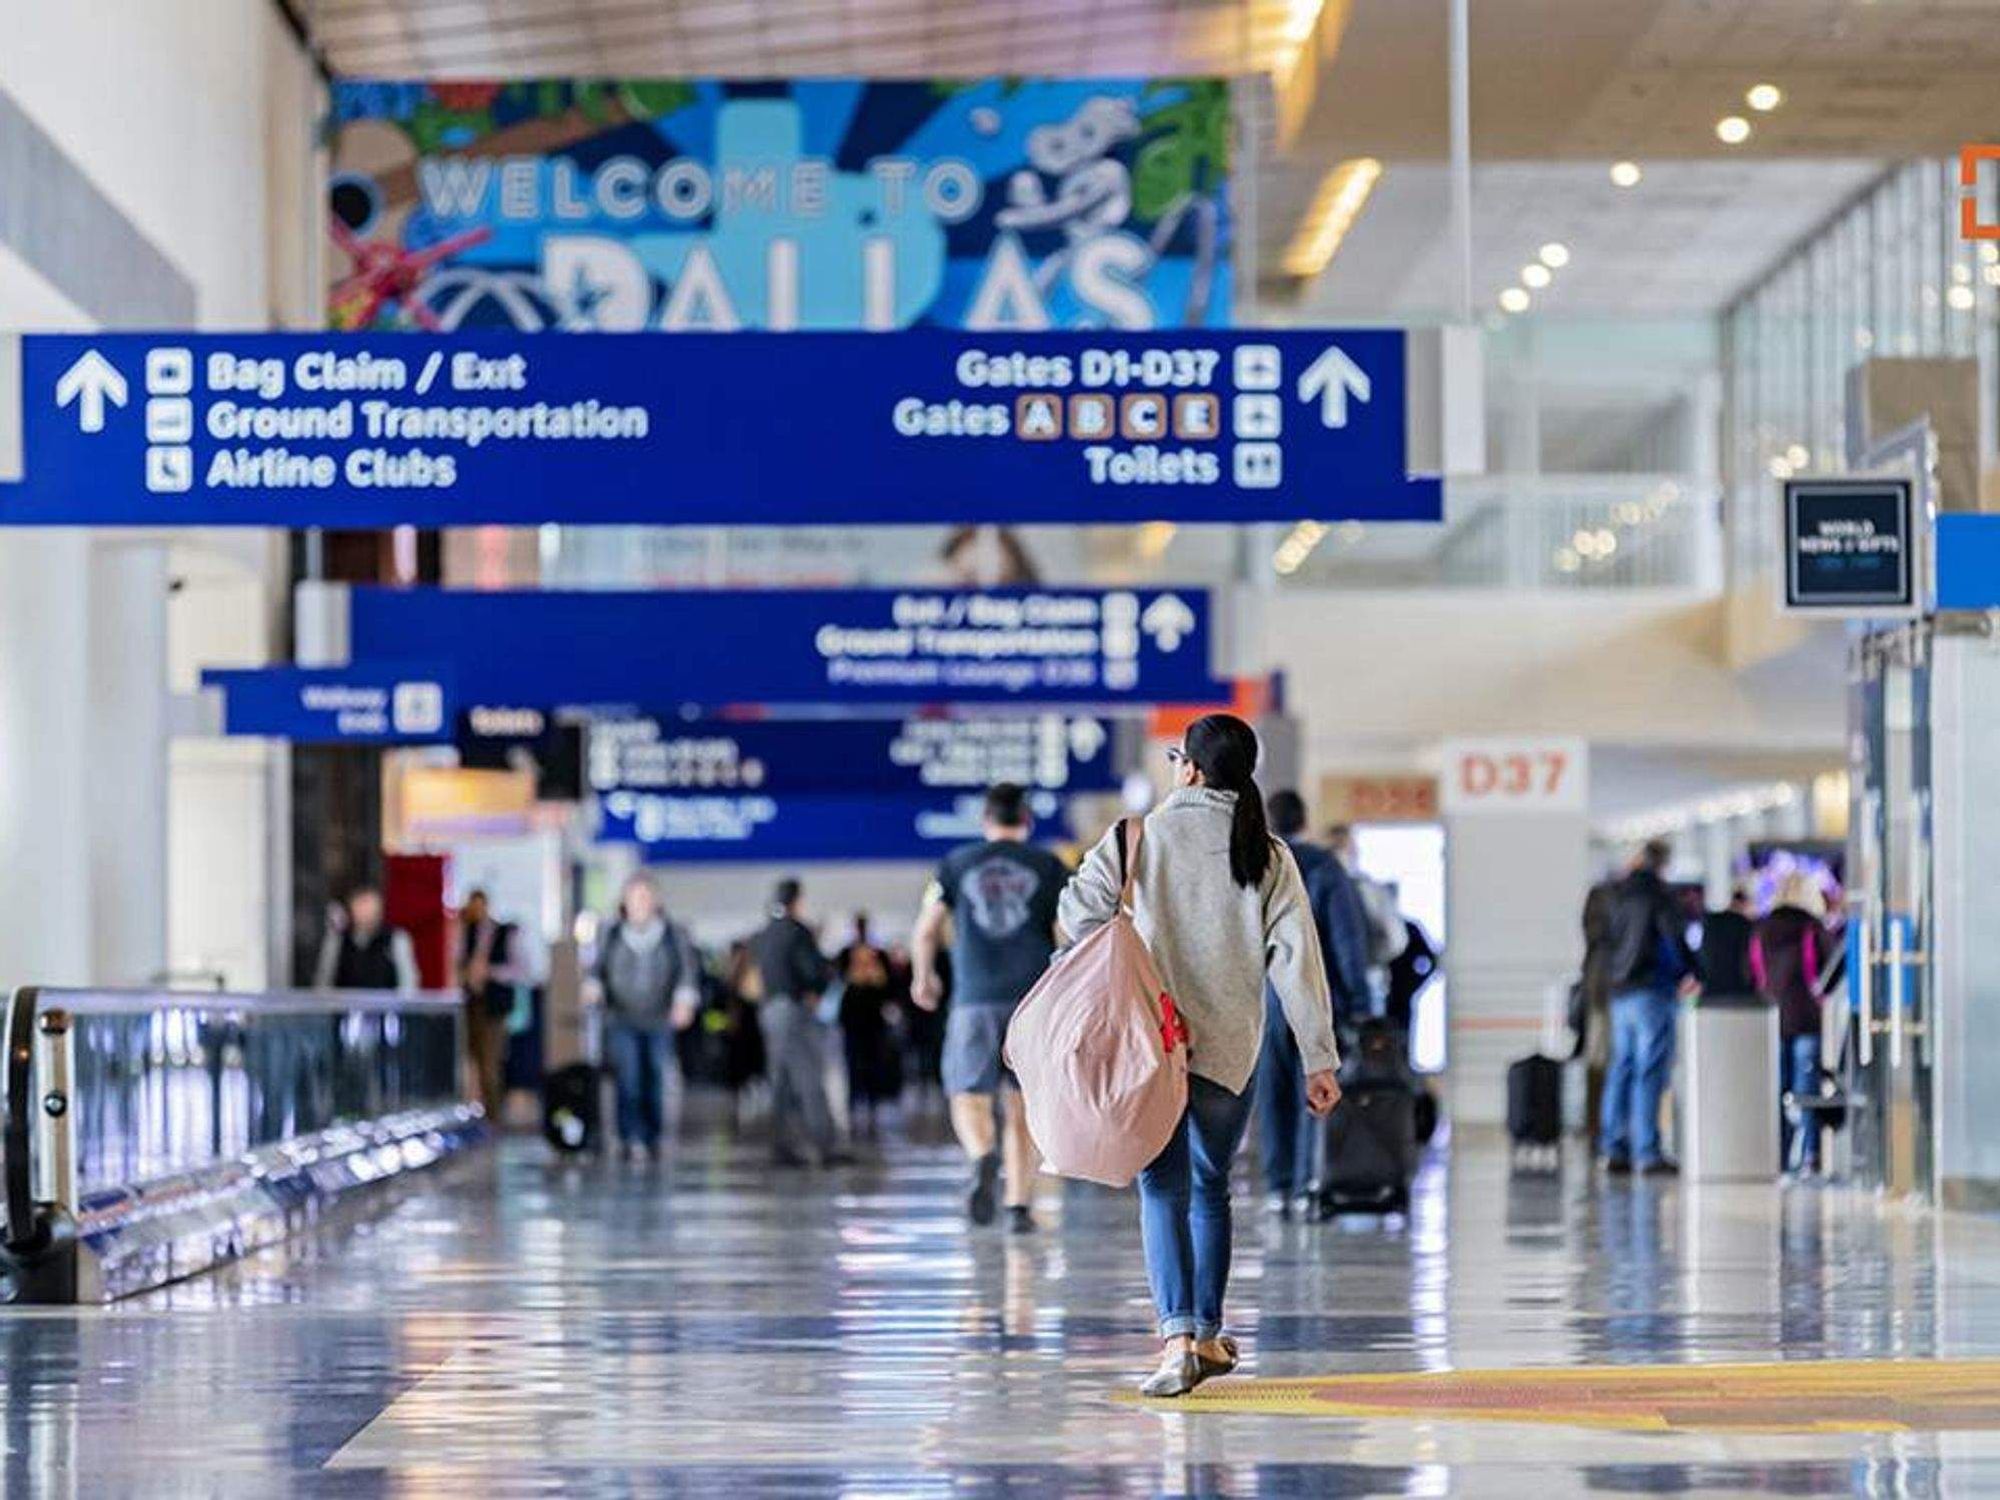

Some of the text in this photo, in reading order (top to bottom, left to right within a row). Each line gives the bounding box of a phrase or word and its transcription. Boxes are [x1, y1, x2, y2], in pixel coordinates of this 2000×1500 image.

[418, 156, 984, 222] WELCOME TO
[206, 352, 527, 398] Bag Claim / Exit
[957, 350, 1220, 387] Gates D1-D37
[206, 400, 649, 447] Ground Transportation
[893, 398, 1214, 437] Gates A B C E
[206, 450, 456, 488] Airline Clubs
[1083, 446, 1220, 484] Toilets
[1461, 752, 1568, 796] D37
